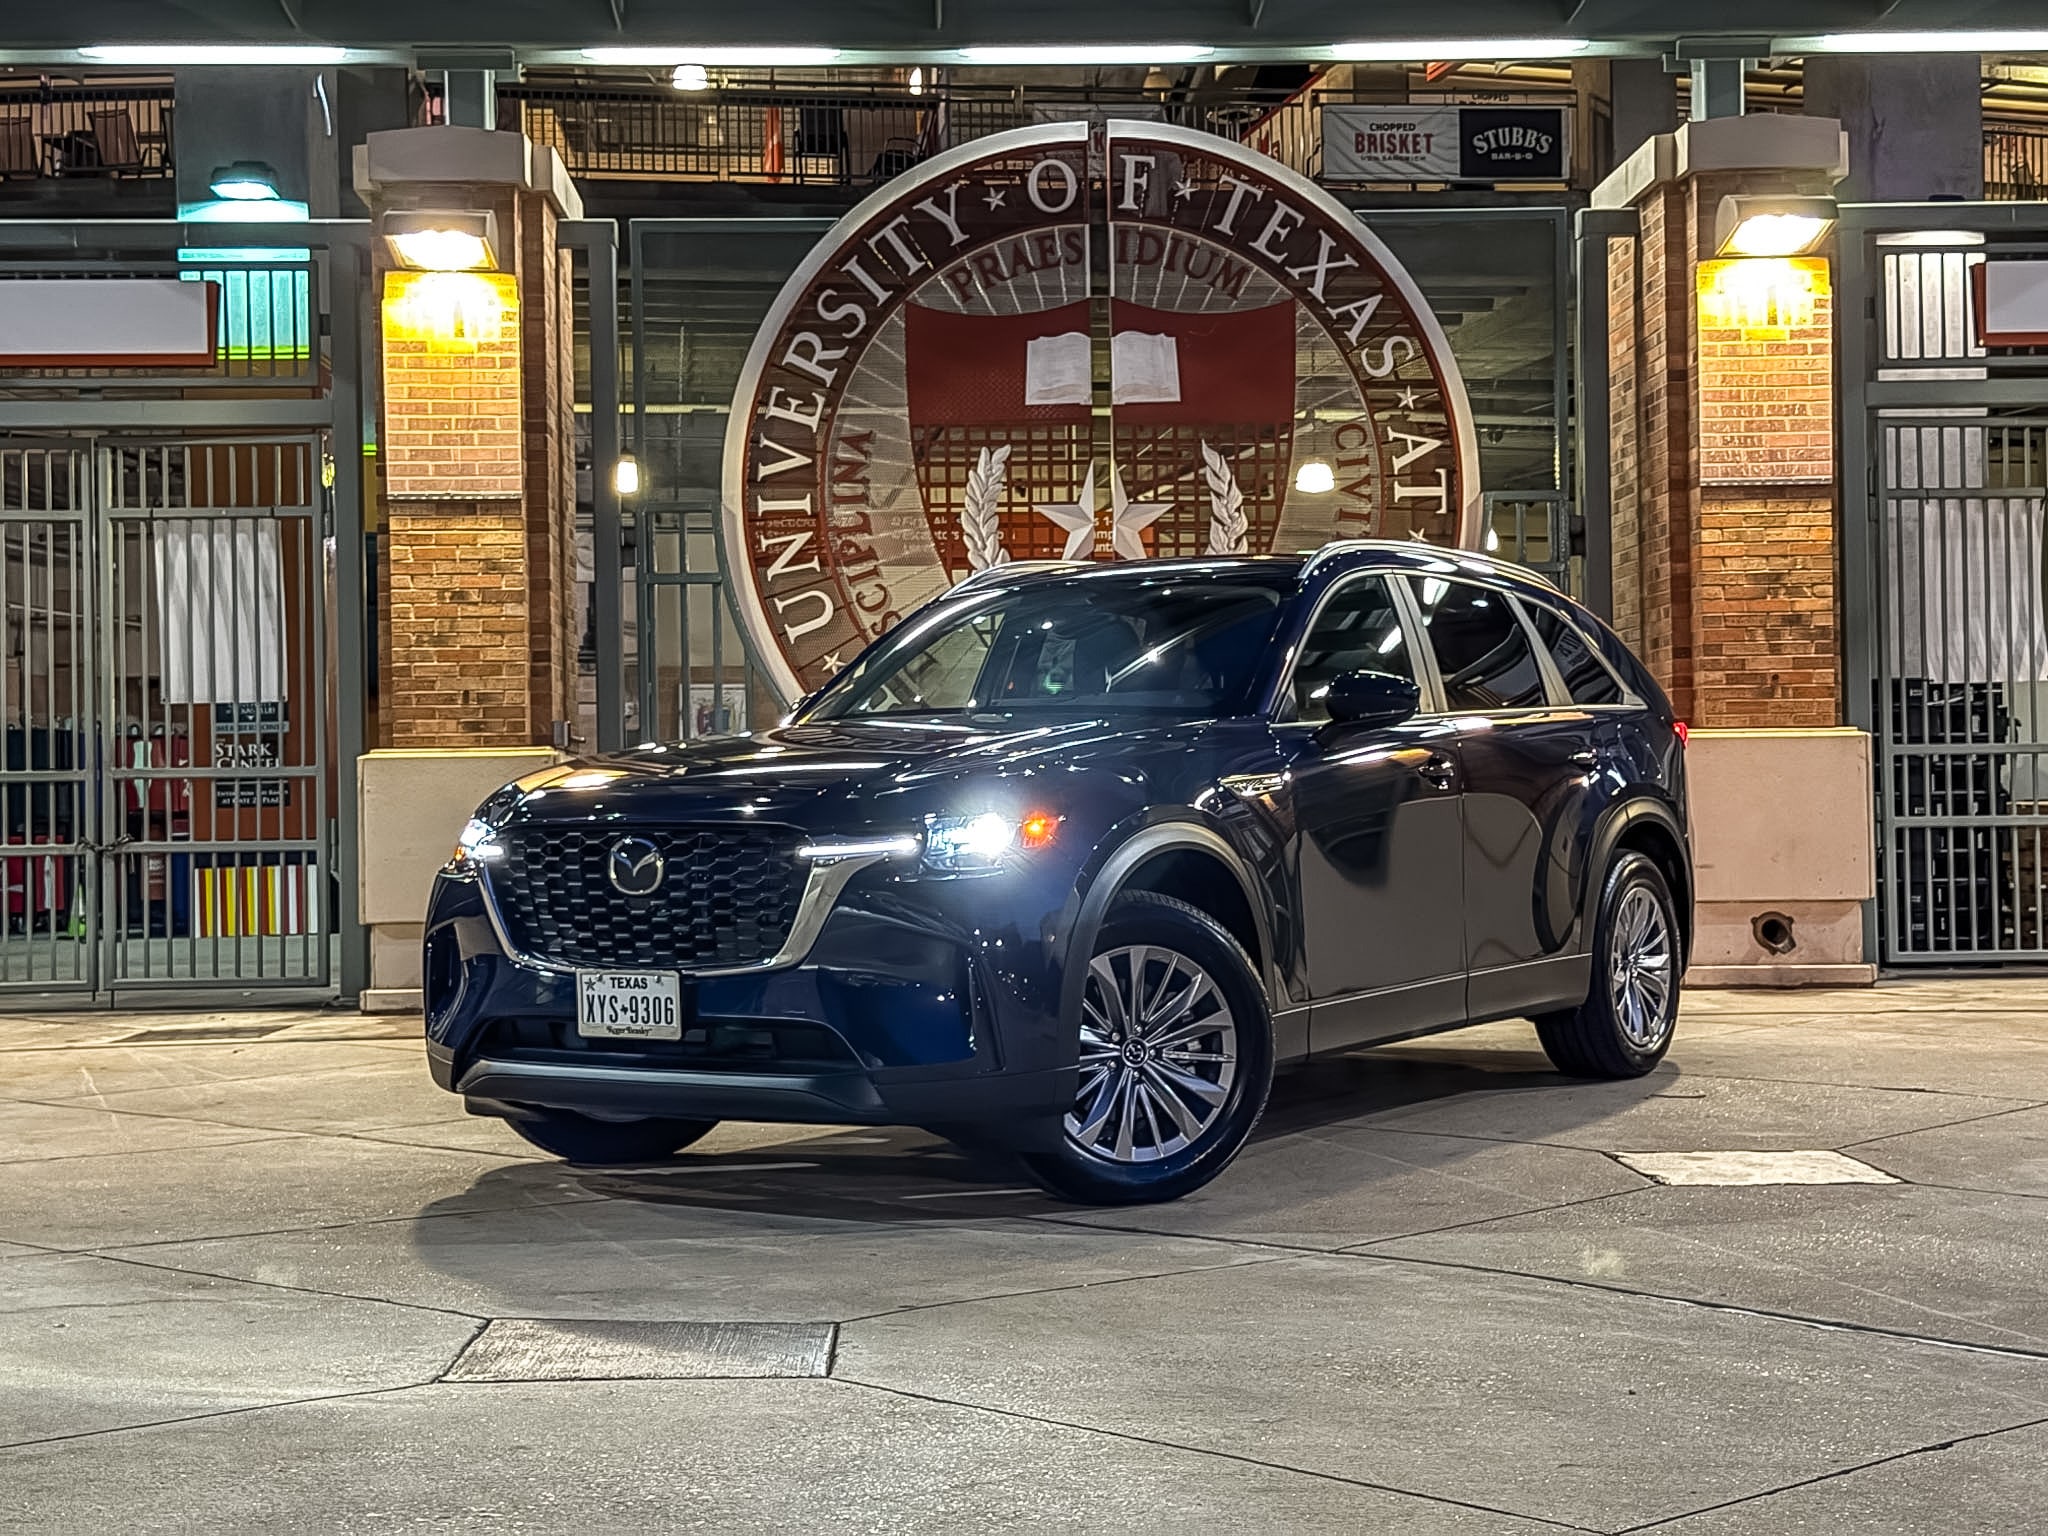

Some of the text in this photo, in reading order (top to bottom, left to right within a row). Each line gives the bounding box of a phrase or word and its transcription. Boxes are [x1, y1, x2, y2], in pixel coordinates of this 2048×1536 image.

[1369, 122, 1416, 132] CHOPPED
[1355, 132, 1434, 154] BRISKET
[1472, 127, 1552, 154] STUBB'S
[757, 154, 1447, 644] UNIVERSITY OF TEXAS AT
[215, 743, 273, 758] STARK
[609, 977, 648, 989] TEXAS
[586, 994, 674, 1025] XYS 9306
